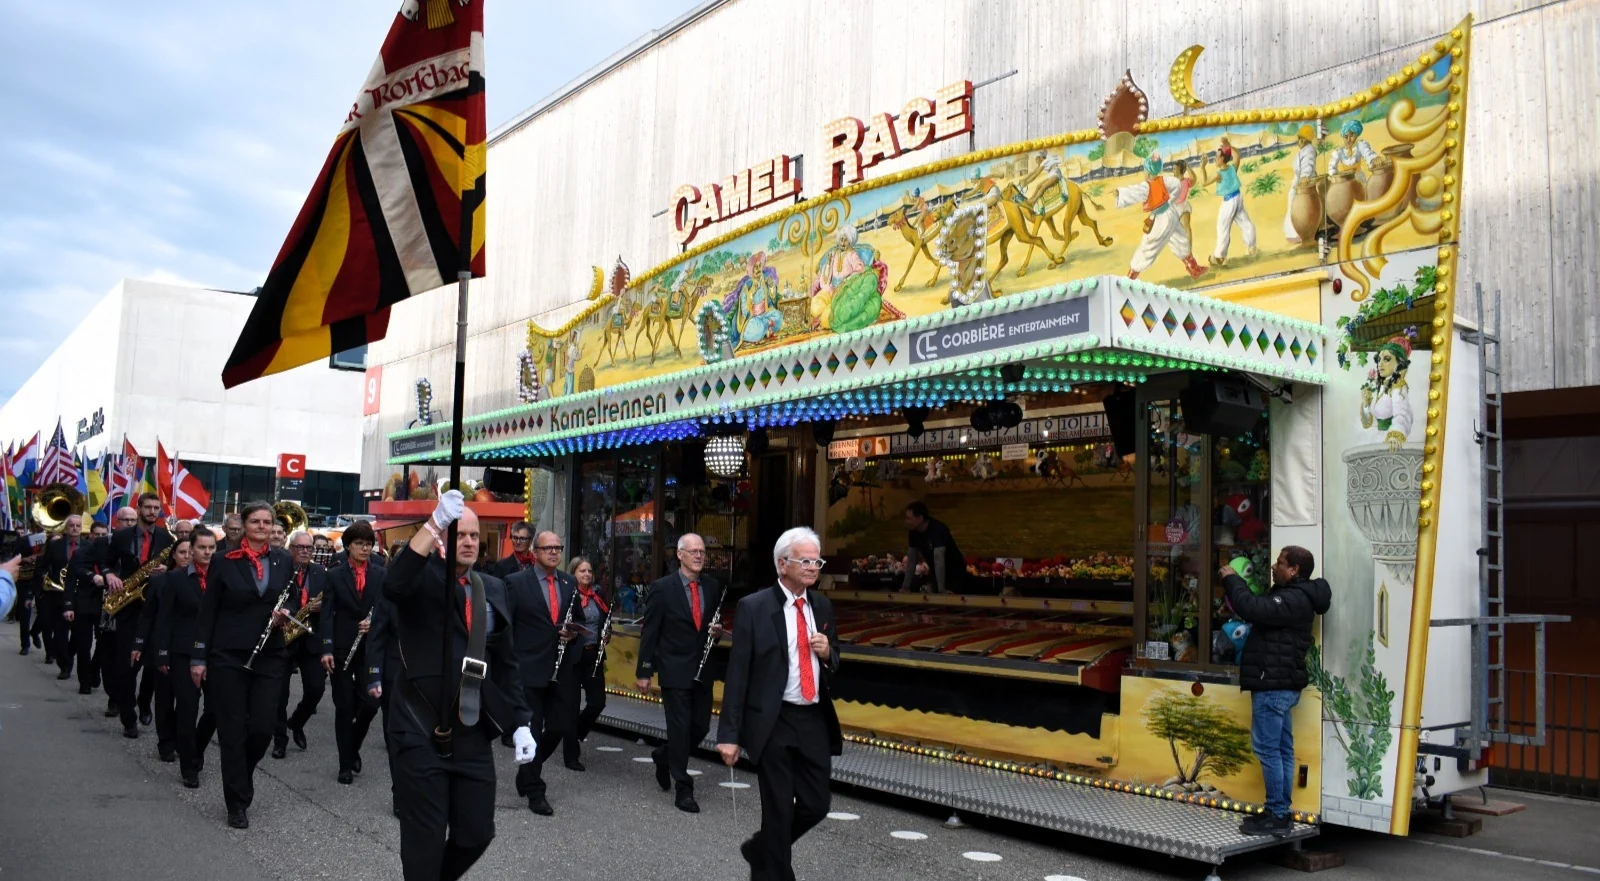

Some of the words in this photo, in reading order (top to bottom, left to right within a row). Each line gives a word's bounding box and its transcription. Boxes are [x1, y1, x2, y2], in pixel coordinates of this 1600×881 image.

[668, 154, 801, 244] CAMEL
[823, 80, 973, 192] RACE
[941, 323, 1005, 349] CORBIÈRE
[1008, 312, 1081, 336] ENTERTAINMENT
[368, 378, 376, 404] 9
[550, 391, 667, 432] Kamelrennen
[930, 431, 937, 443] 3
[947, 430, 954, 441] 4
[966, 428, 973, 440] 5
[1024, 422, 1032, 434] 8
[1044, 420, 1053, 431] 9
[1060, 417, 1079, 431] 10
[1084, 415, 1100, 428] 11
[1039, 431, 1058, 441] VSIR
[286, 458, 300, 473] C
